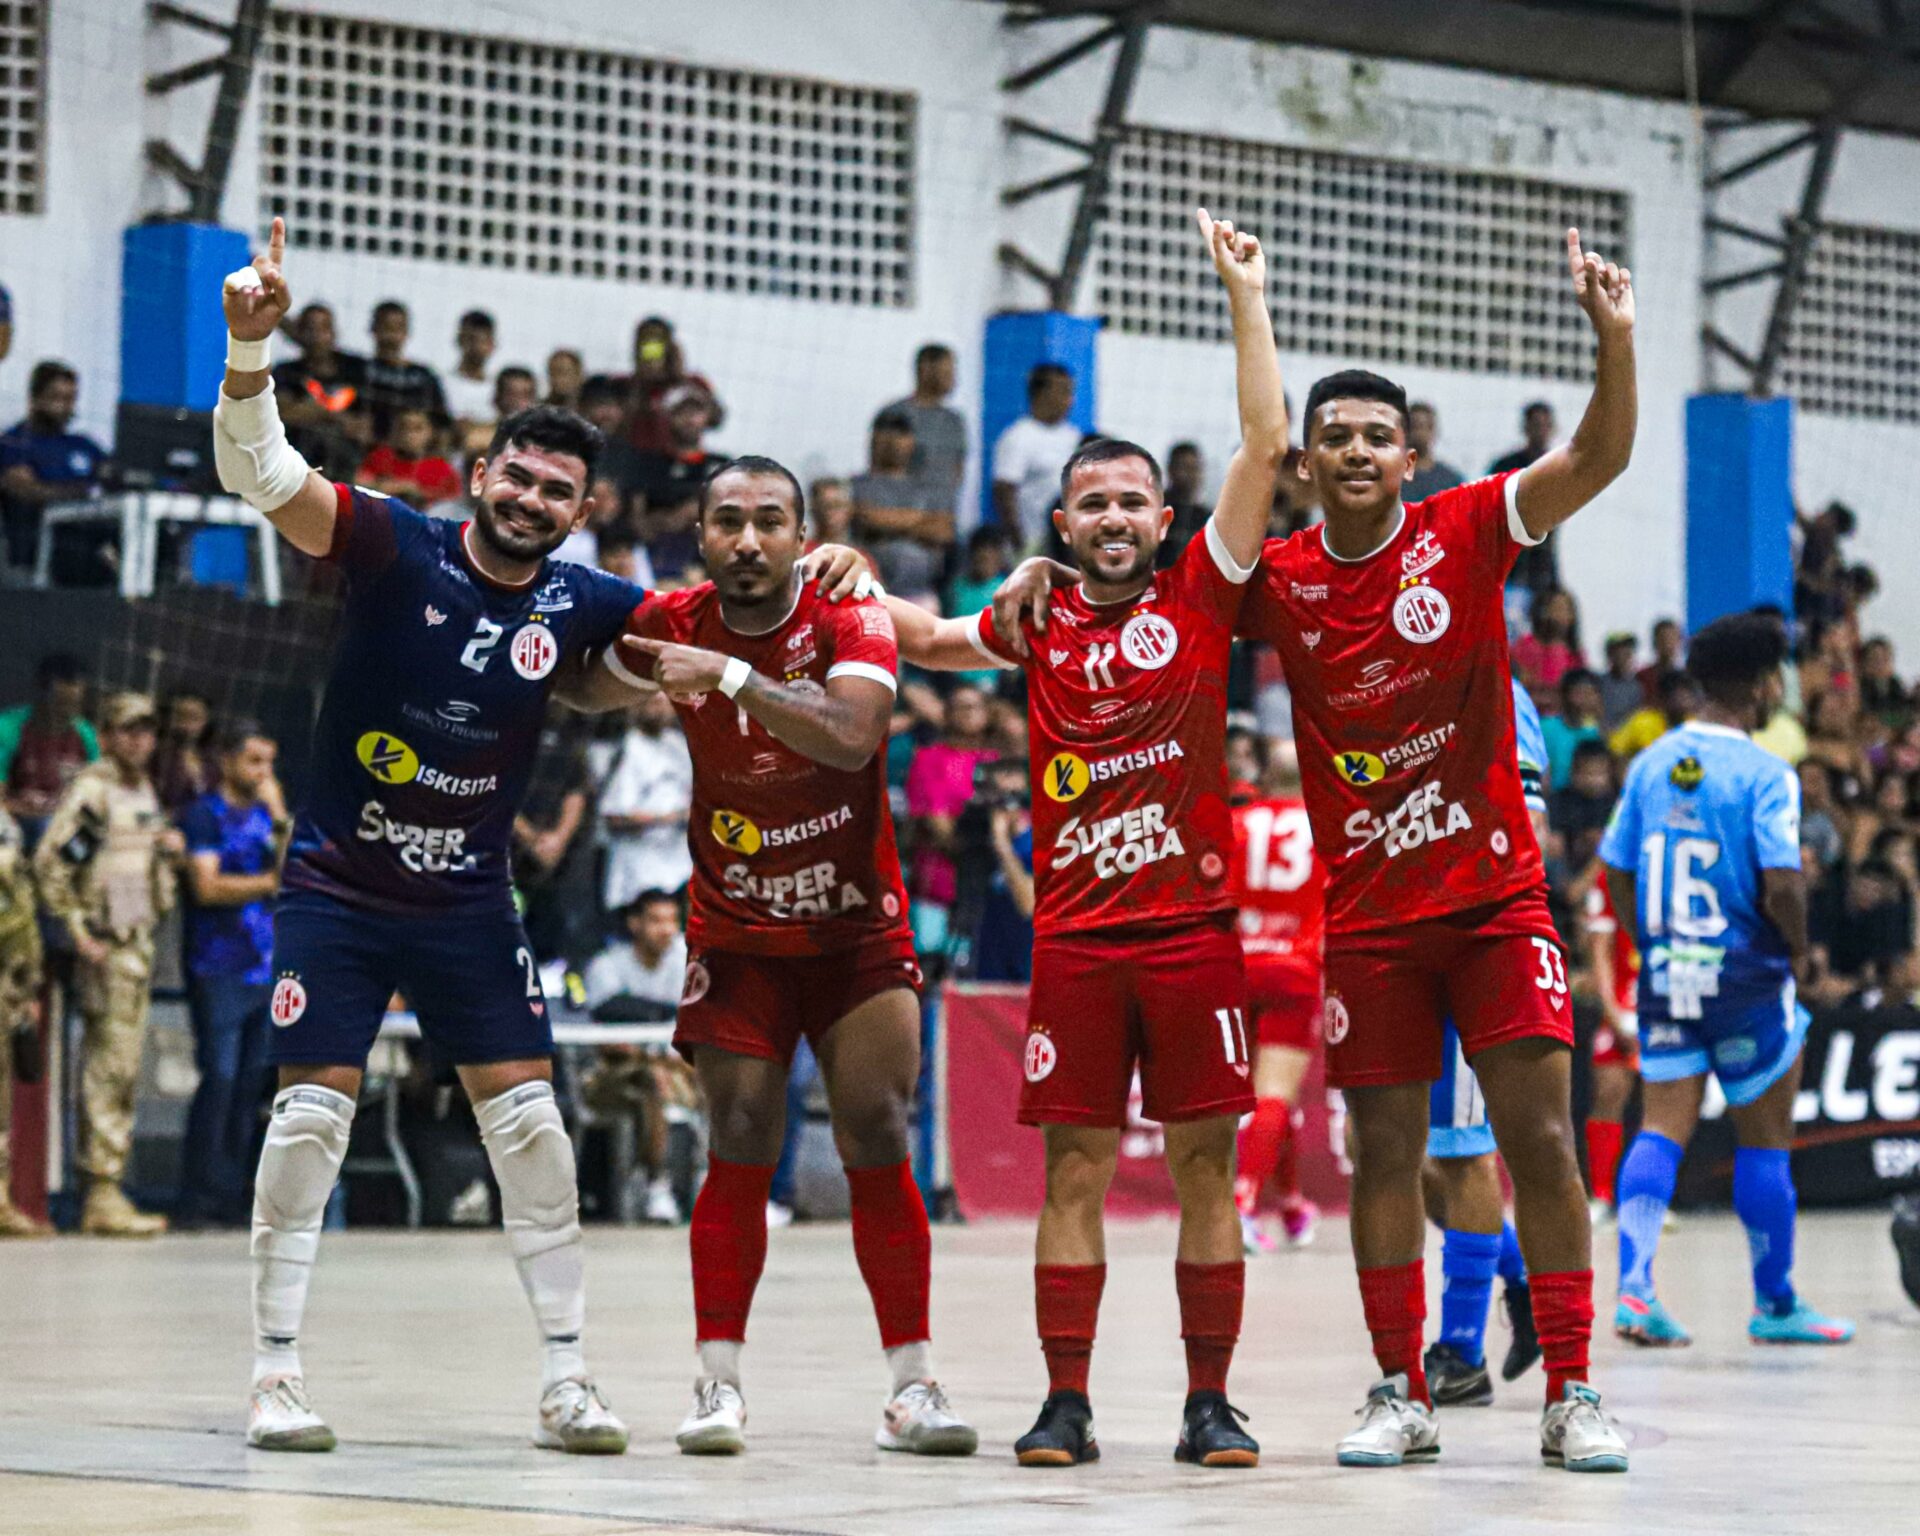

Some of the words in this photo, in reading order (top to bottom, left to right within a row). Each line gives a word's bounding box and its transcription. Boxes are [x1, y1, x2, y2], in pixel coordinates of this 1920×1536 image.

[1130, 623, 1168, 660] AFC
[1403, 595, 1441, 635] AFC
[461, 617, 503, 673] 2
[519, 632, 550, 671] AFC
[1083, 642, 1116, 691] 11
[356, 800, 466, 856] SUPER
[1052, 803, 1166, 870] SUPER
[1094, 827, 1185, 880] COLA
[1244, 806, 1314, 892] 13
[1385, 802, 1473, 858] COLA
[723, 861, 837, 903] SUPER
[1642, 832, 1729, 939] 16
[516, 946, 541, 997] 2
[1531, 936, 1567, 994] 33
[1215, 1007, 1249, 1064] 11
